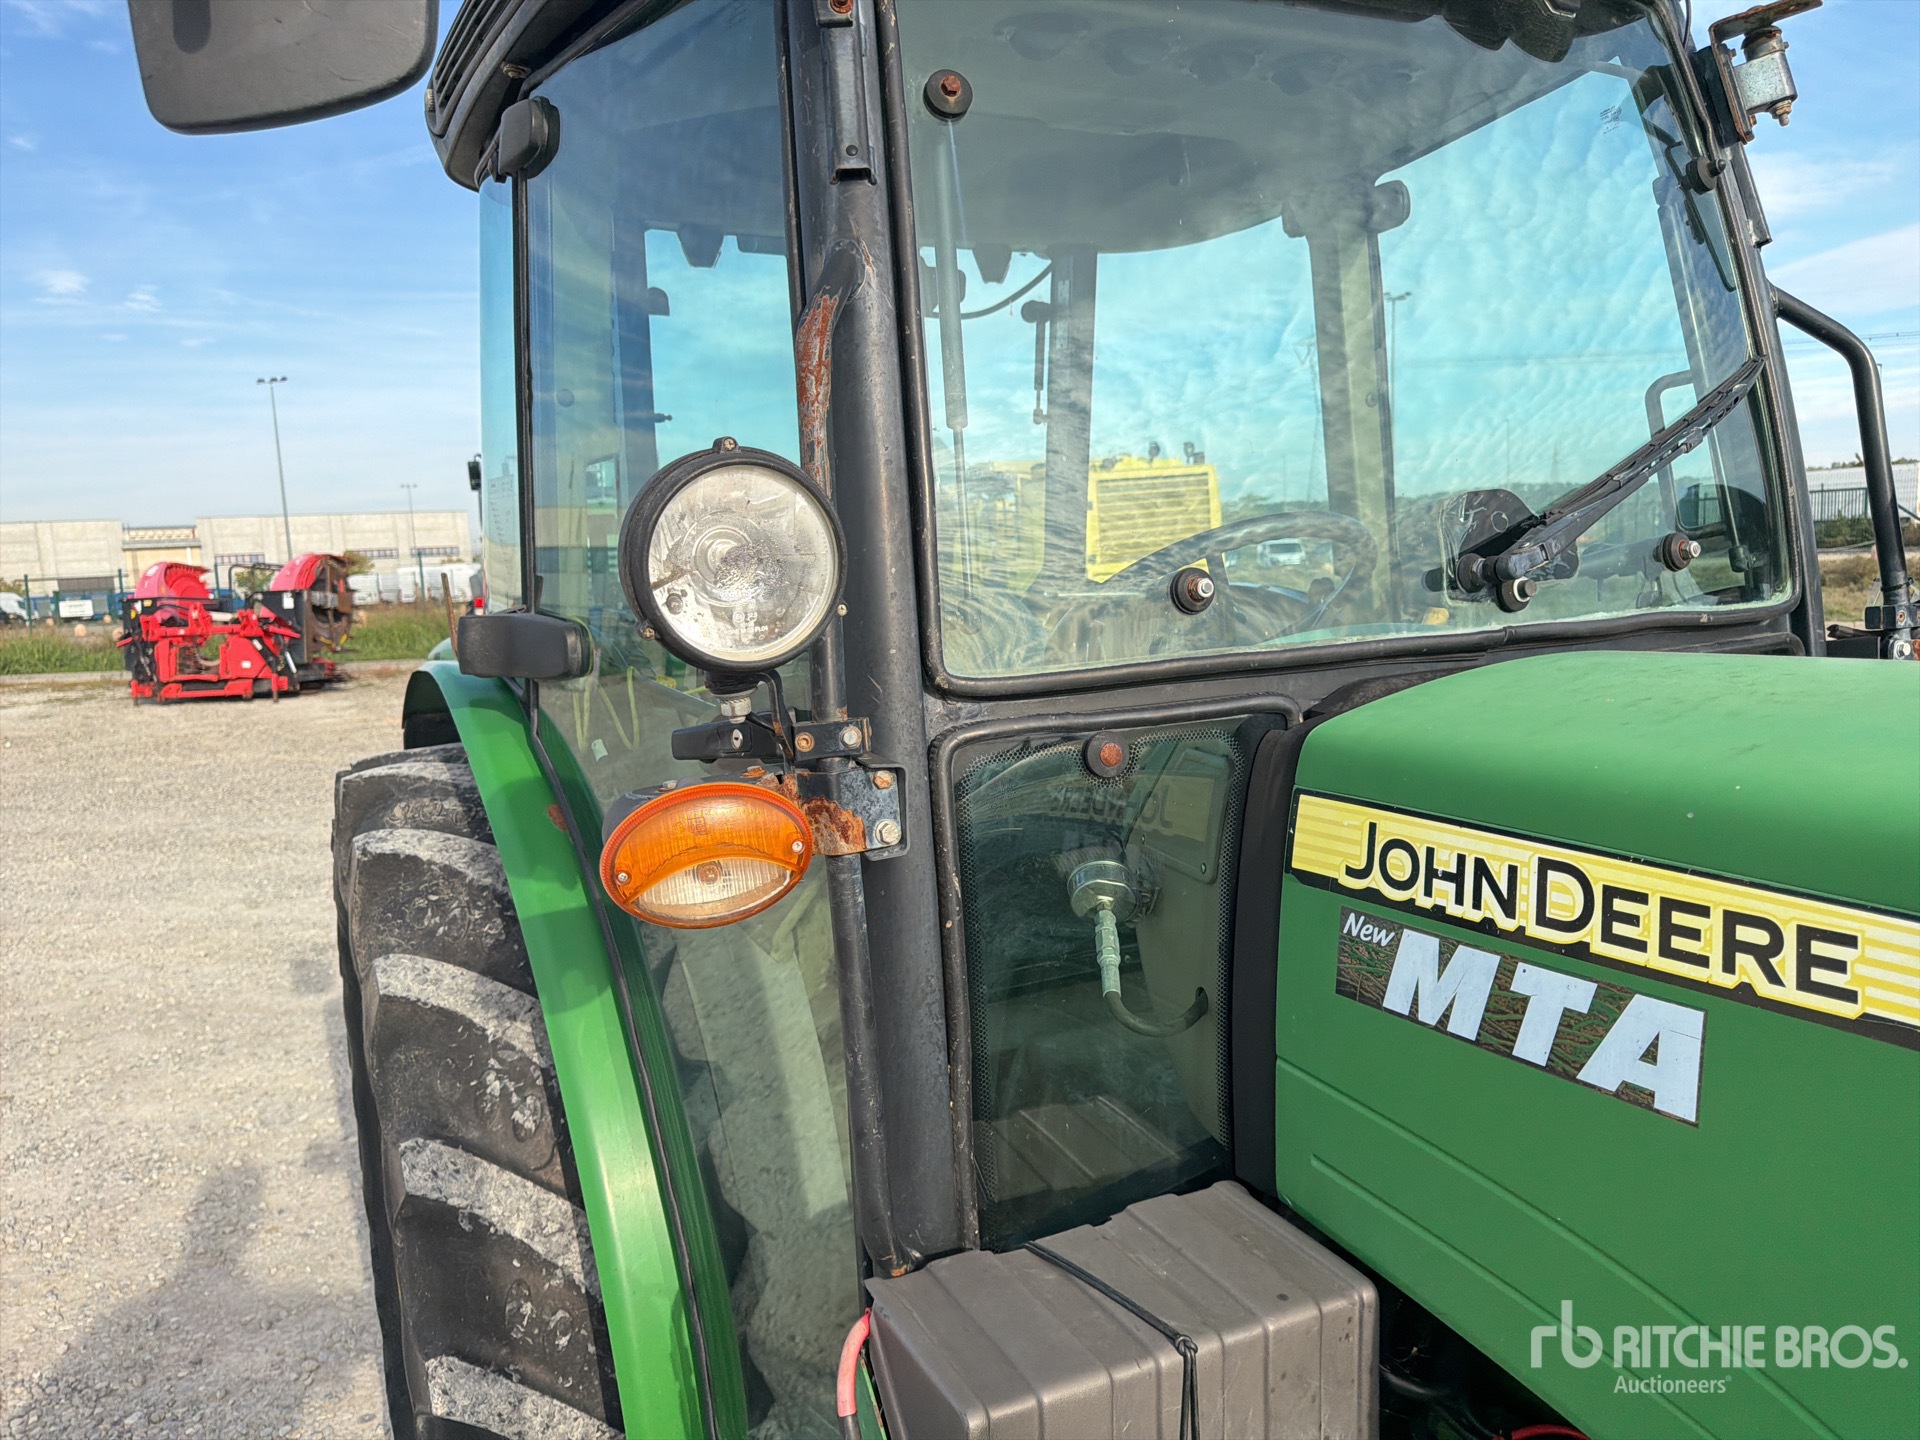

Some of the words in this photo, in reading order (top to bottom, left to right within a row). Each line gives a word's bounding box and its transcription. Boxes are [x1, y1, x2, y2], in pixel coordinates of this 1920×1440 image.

[1345, 821, 1519, 920] JOHN
[1536, 856, 1859, 1005] DEERE
[1344, 913, 1395, 947] New
[1383, 929, 1705, 1122] MTA
